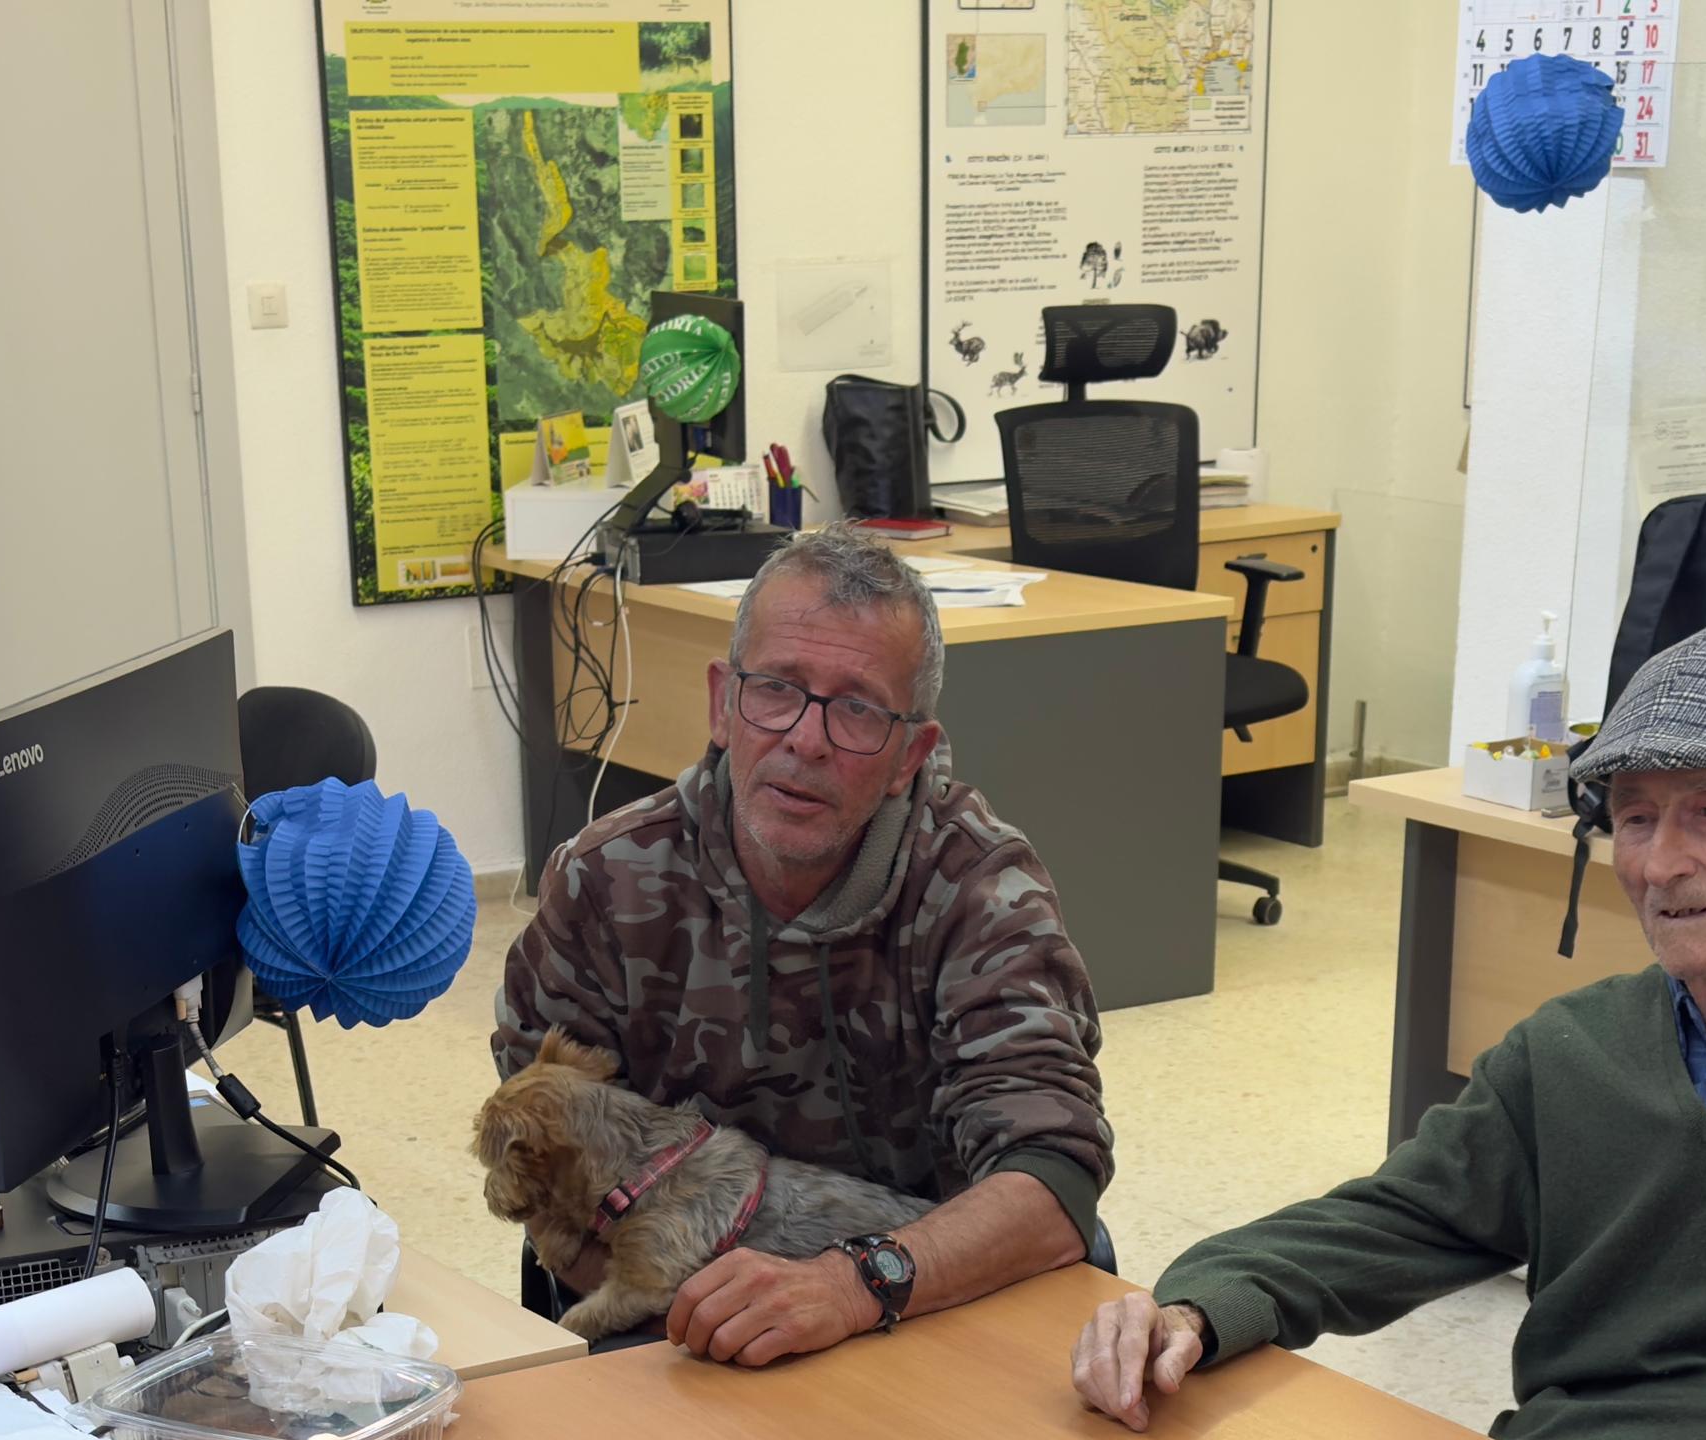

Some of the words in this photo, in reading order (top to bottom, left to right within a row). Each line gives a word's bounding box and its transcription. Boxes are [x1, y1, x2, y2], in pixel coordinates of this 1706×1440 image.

[1476, 29, 1485, 51] 4
[1504, 29, 1514, 51] 5
[1533, 28, 1543, 51] 6
[1563, 27, 1573, 50] 7
[1592, 26, 1601, 49] 8
[1620, 26, 1629, 49] 9
[1645, 24, 1659, 48] 10
[1472, 63, 1484, 86] 11
[1641, 61, 1656, 84] 17
[1637, 96, 1654, 120] 24
[1634, 132, 1649, 156] 31
